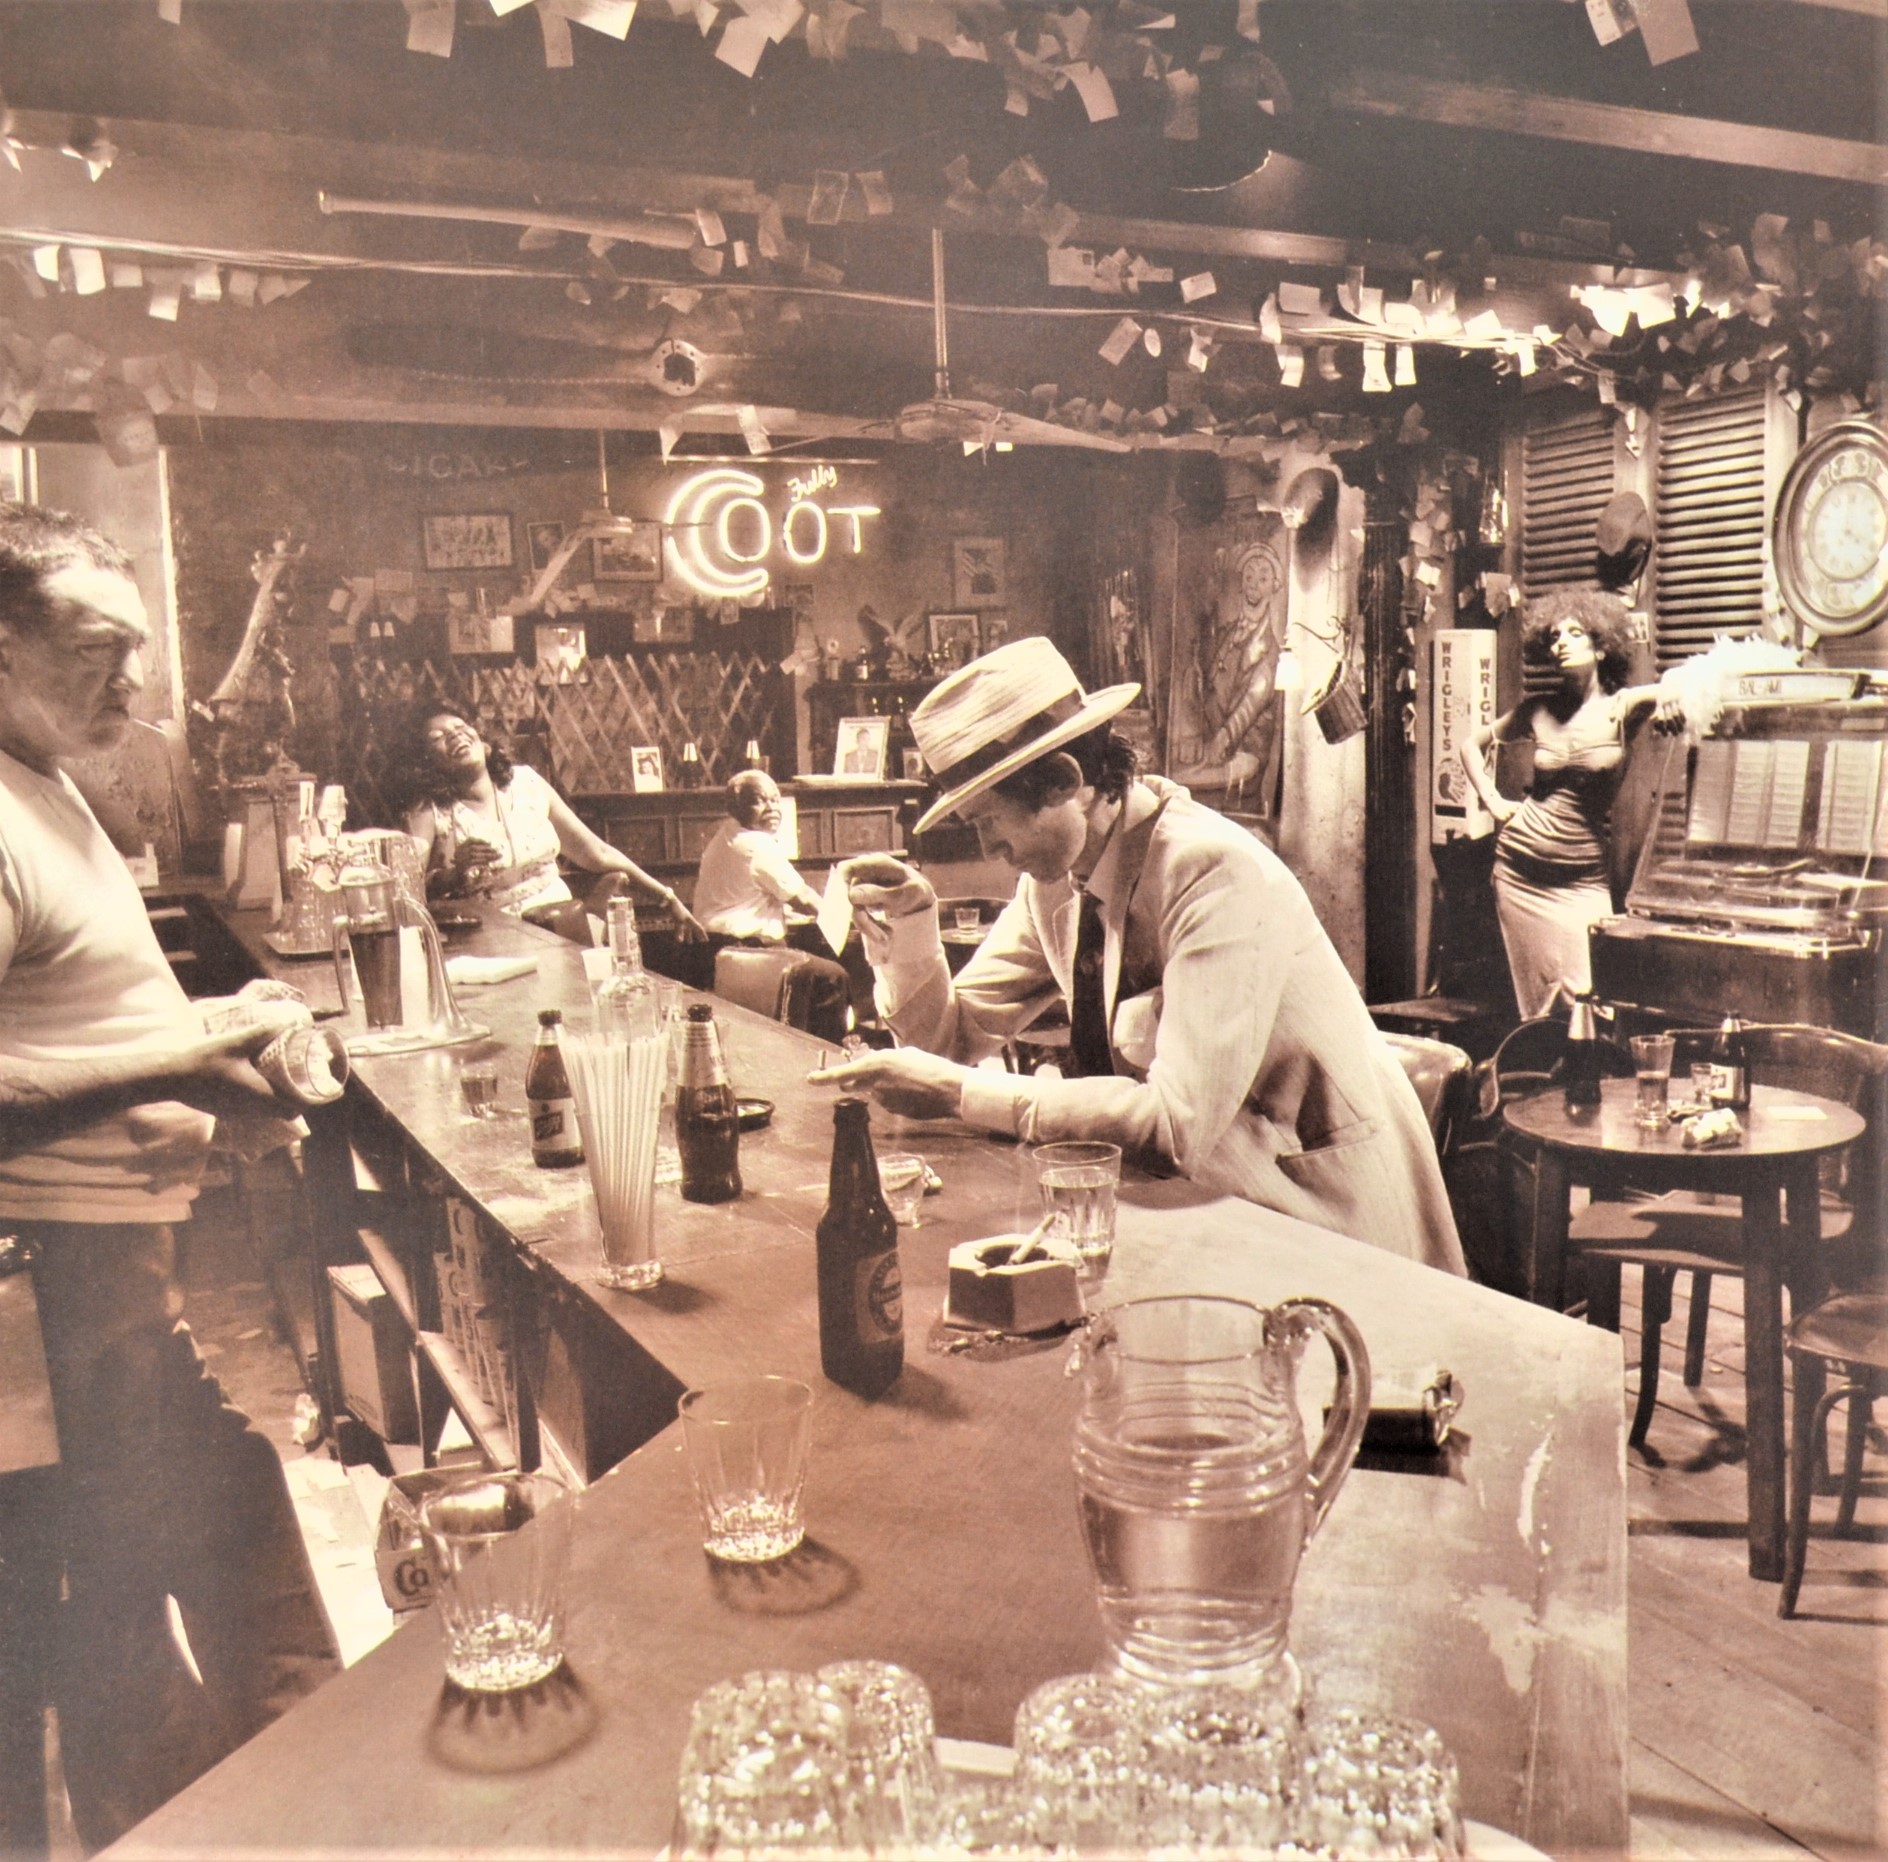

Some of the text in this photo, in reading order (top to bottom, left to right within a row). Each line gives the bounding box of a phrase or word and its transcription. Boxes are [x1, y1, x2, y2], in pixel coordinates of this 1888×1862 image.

[663, 468, 882, 598] COOT
[1441, 641, 1452, 751] WRIGLEYS
[1479, 657, 1491, 726] WRIGL
